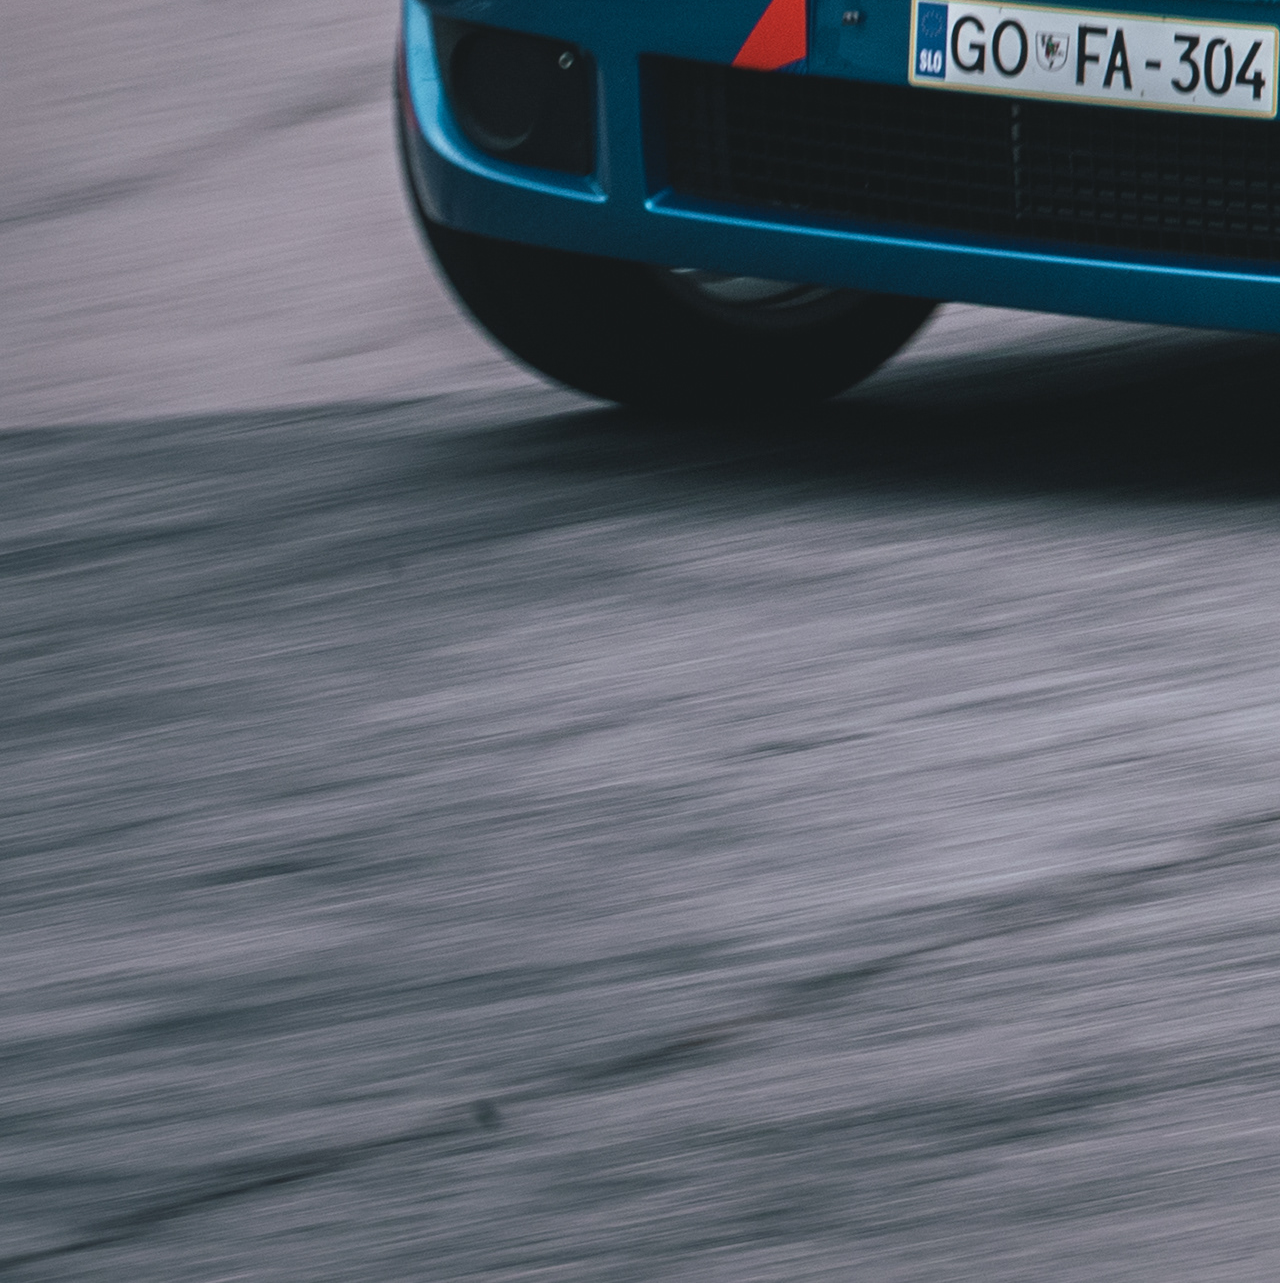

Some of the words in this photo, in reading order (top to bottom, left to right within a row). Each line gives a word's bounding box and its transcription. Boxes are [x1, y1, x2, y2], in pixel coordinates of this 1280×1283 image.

[919, 49, 942, 74] SLO
[950, 15, 1029, 77] GO
[1075, 23, 1266, 102] FA-304
